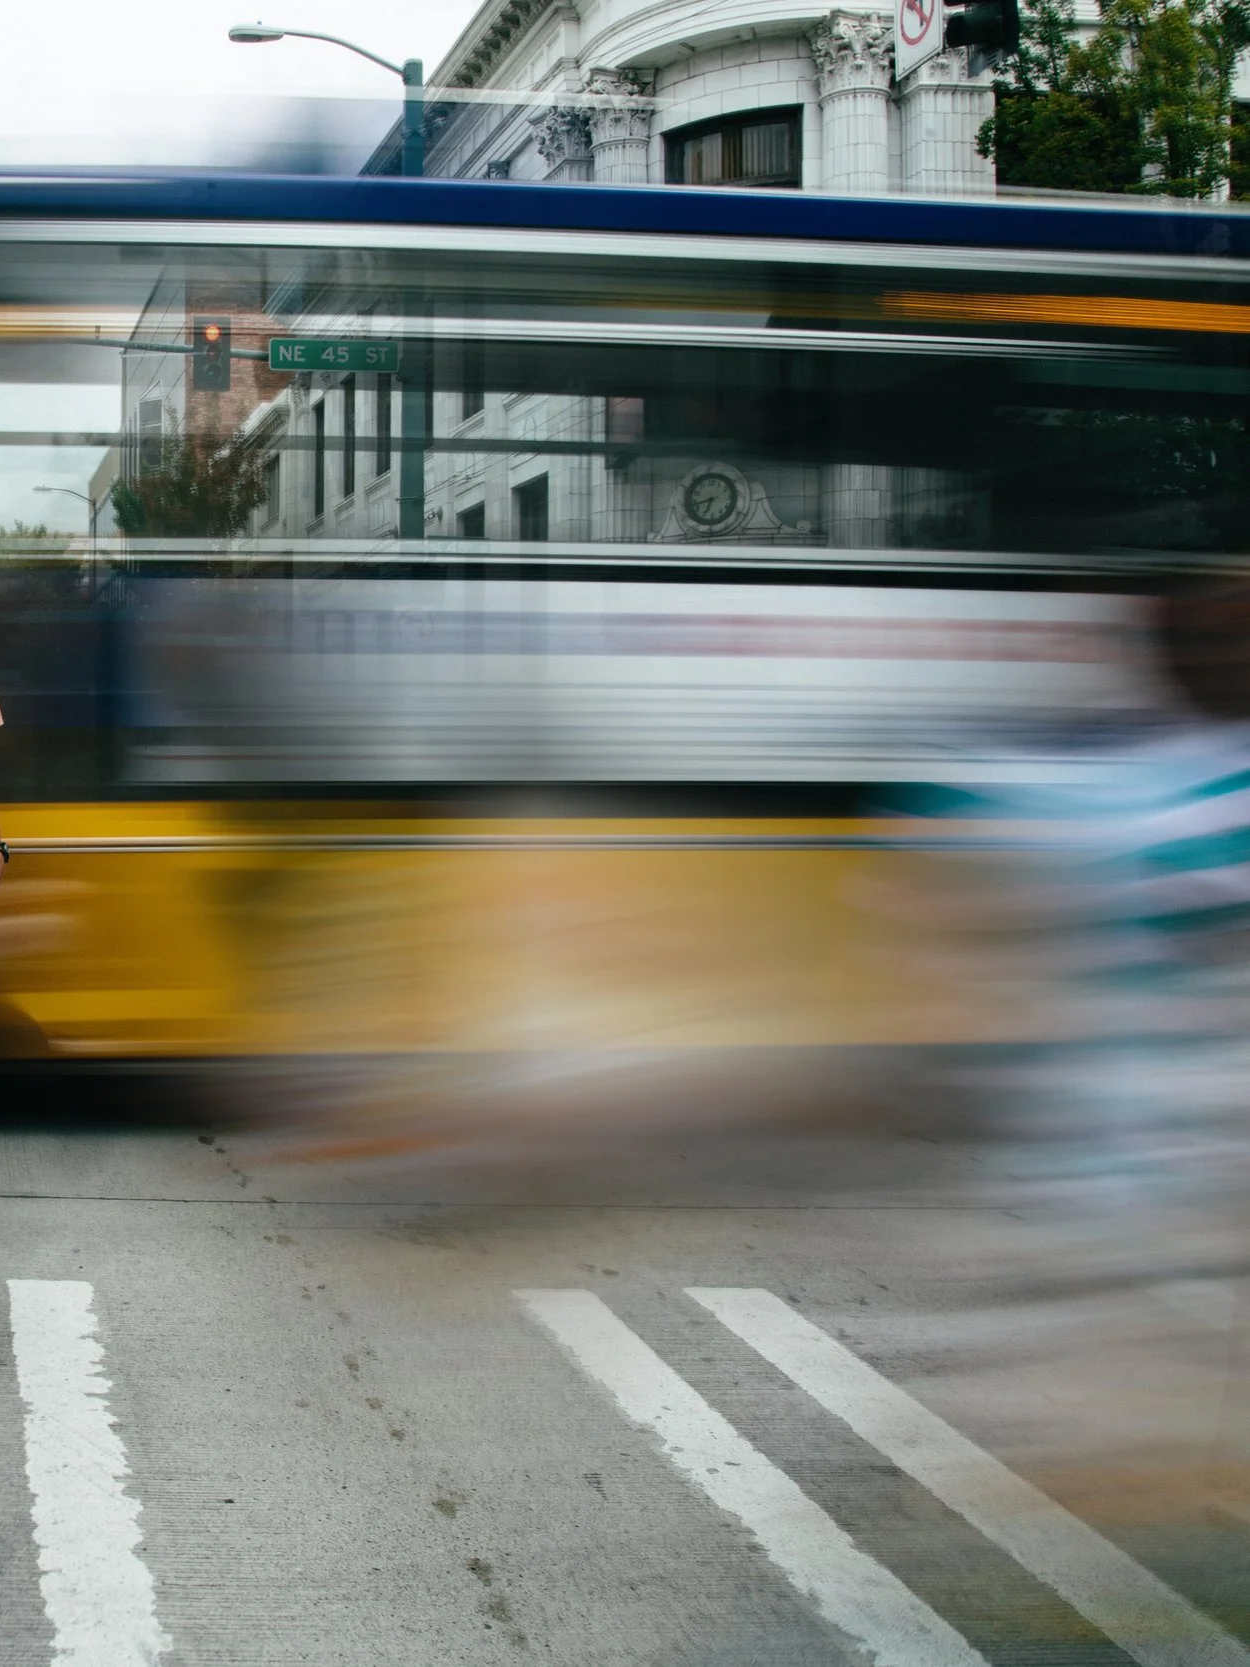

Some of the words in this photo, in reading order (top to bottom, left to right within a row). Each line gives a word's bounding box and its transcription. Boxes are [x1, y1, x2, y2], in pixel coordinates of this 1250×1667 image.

[279, 345, 306, 362] NE
[321, 346, 349, 363] 45
[366, 347, 389, 364] ST
